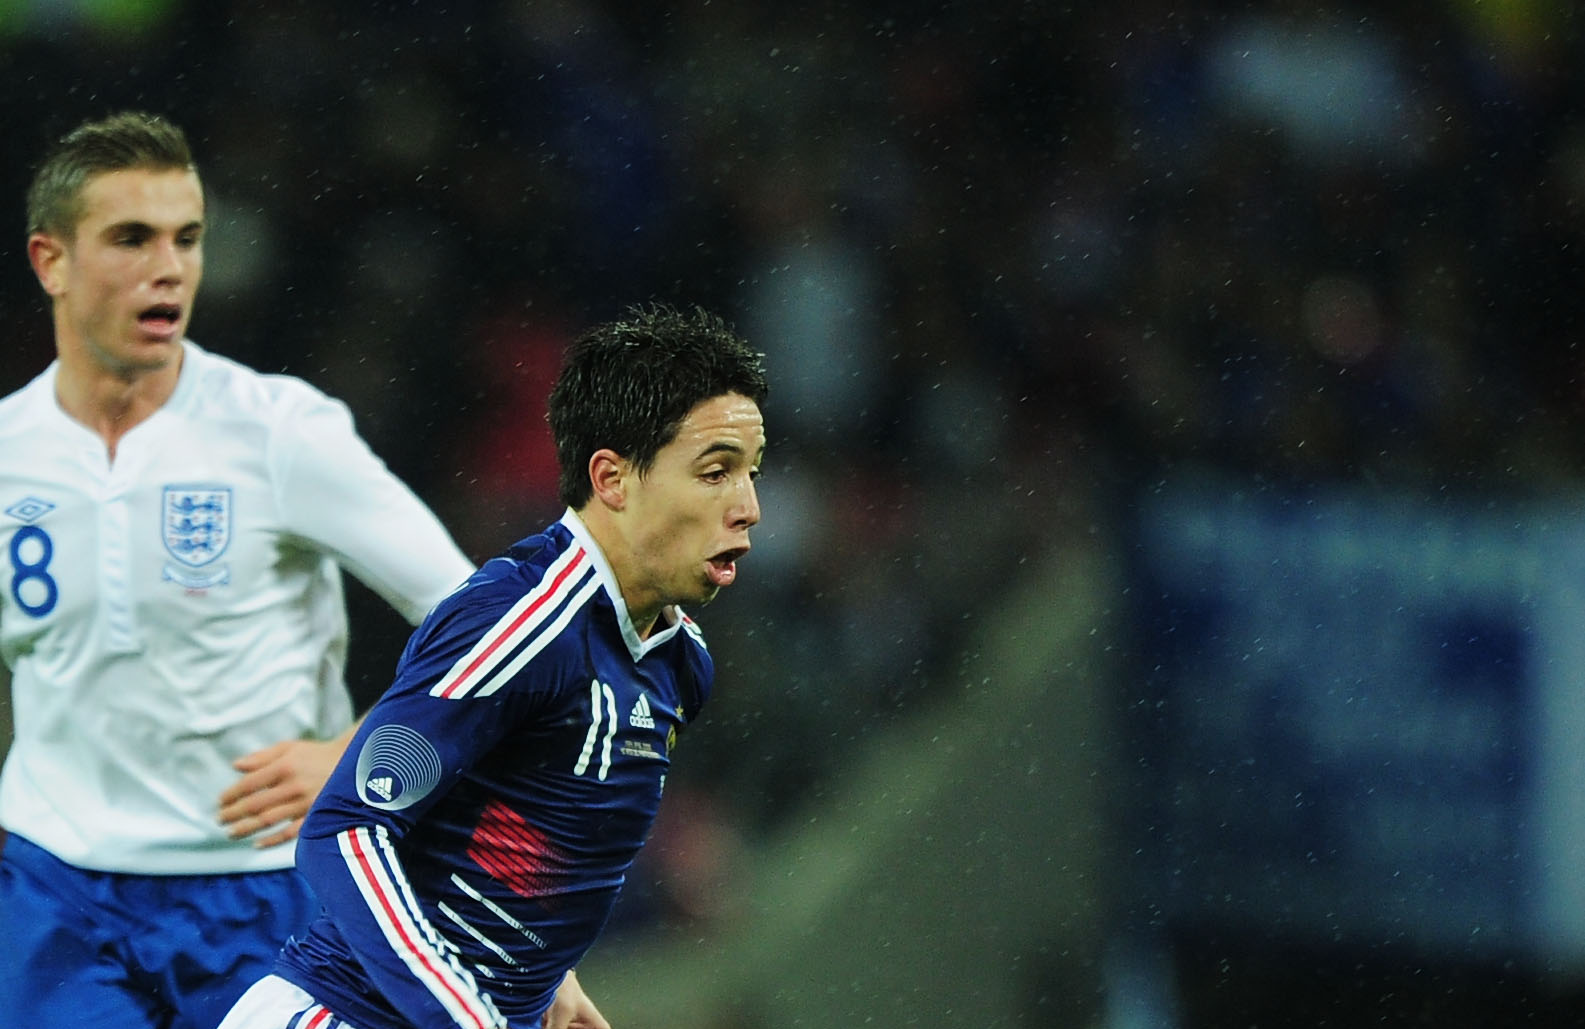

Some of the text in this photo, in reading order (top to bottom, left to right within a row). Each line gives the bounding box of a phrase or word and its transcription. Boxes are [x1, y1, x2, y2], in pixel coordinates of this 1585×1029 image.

[9, 525, 59, 618] 8
[573, 679, 617, 781] 11
[629, 714, 655, 729] adidas
